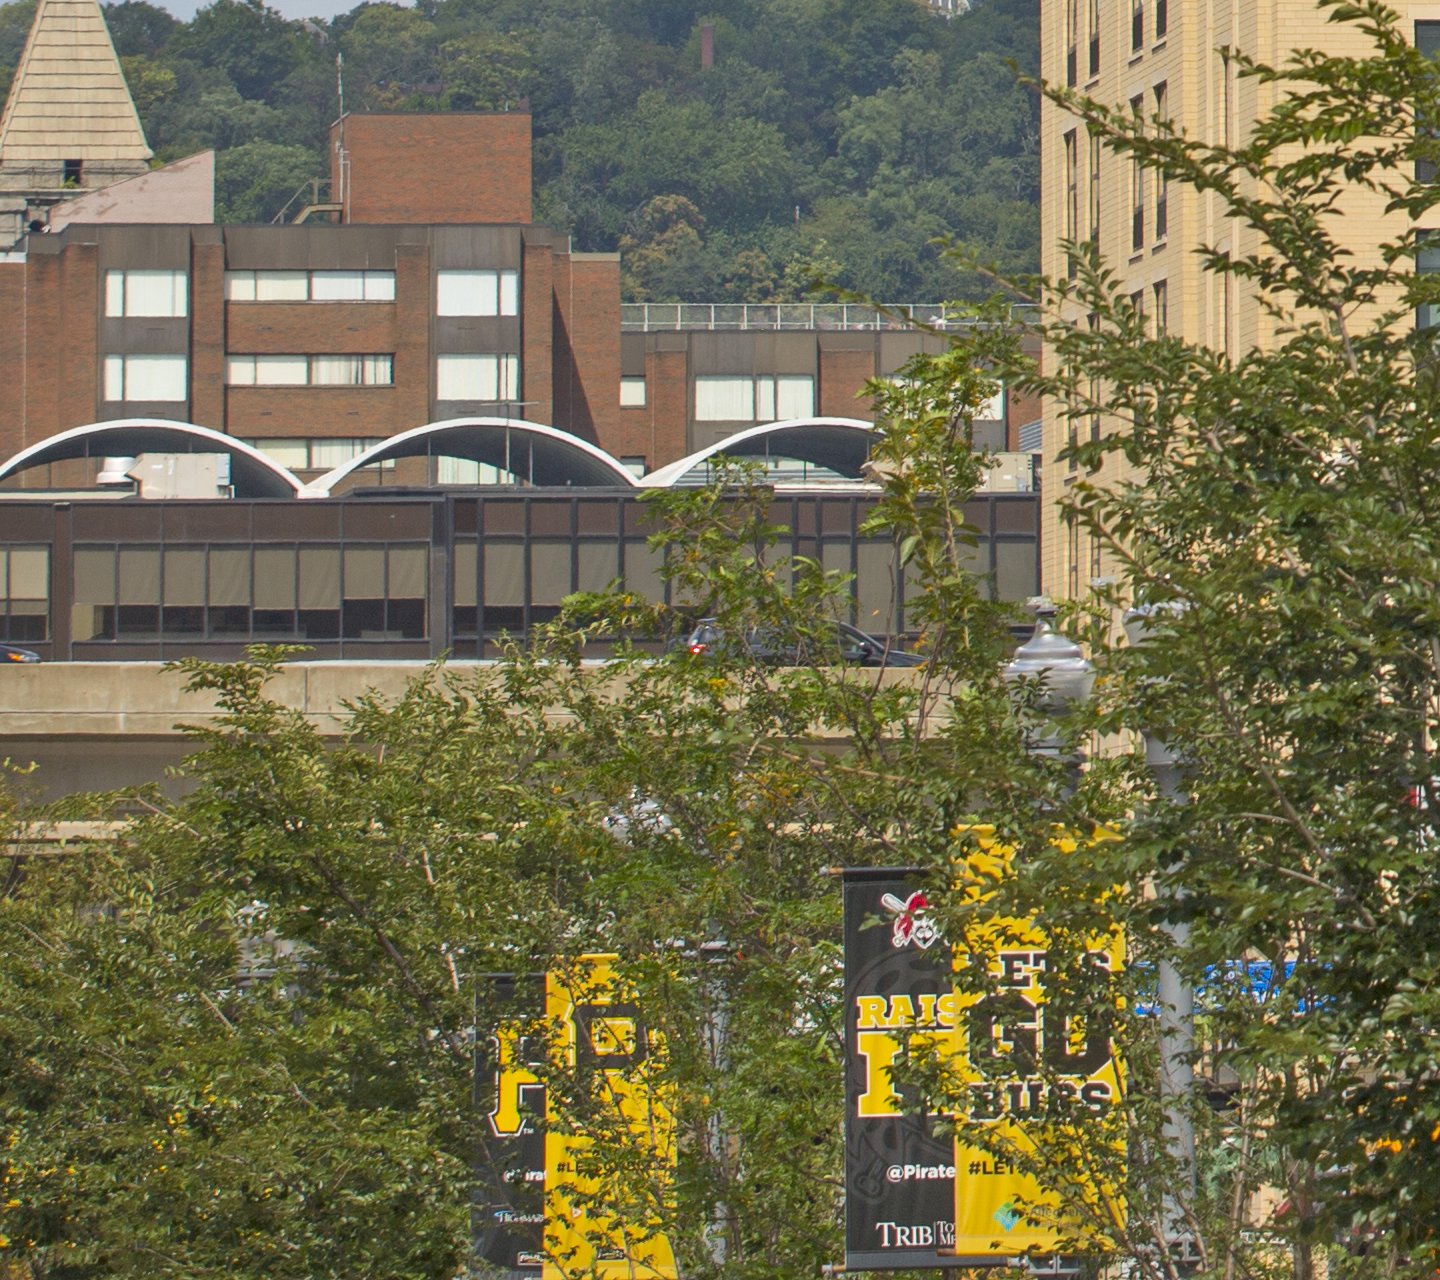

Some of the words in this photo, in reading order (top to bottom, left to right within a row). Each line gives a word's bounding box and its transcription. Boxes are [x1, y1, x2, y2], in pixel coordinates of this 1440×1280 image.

[857, 994, 954, 1029] RAIS
[886, 1163, 956, 1183] @Pirate
[876, 1222, 932, 1248] TRIB
